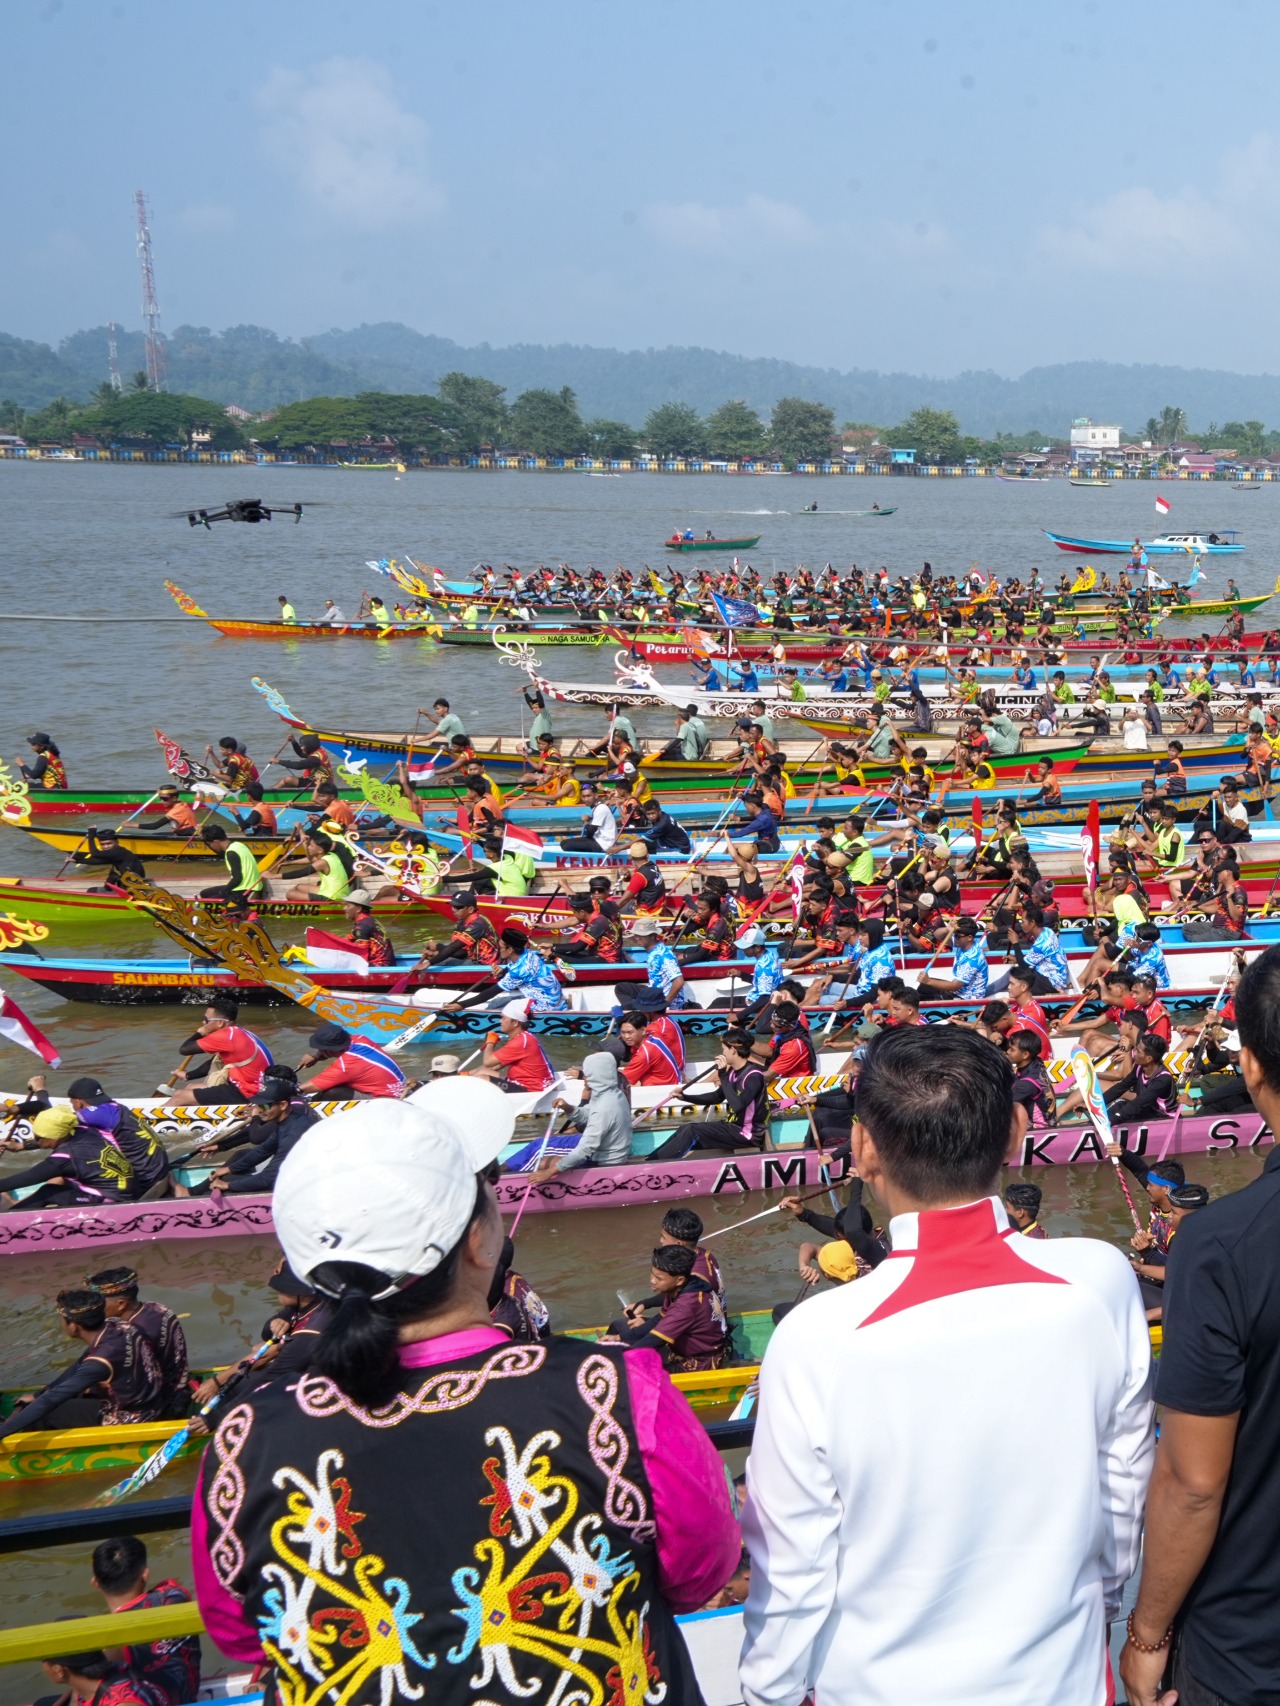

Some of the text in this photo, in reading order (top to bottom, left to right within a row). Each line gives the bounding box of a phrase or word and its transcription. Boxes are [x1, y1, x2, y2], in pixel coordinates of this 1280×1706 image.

[547, 635, 611, 643] NAGA SAMUDA
[113, 972, 216, 986] SALIMBATU
